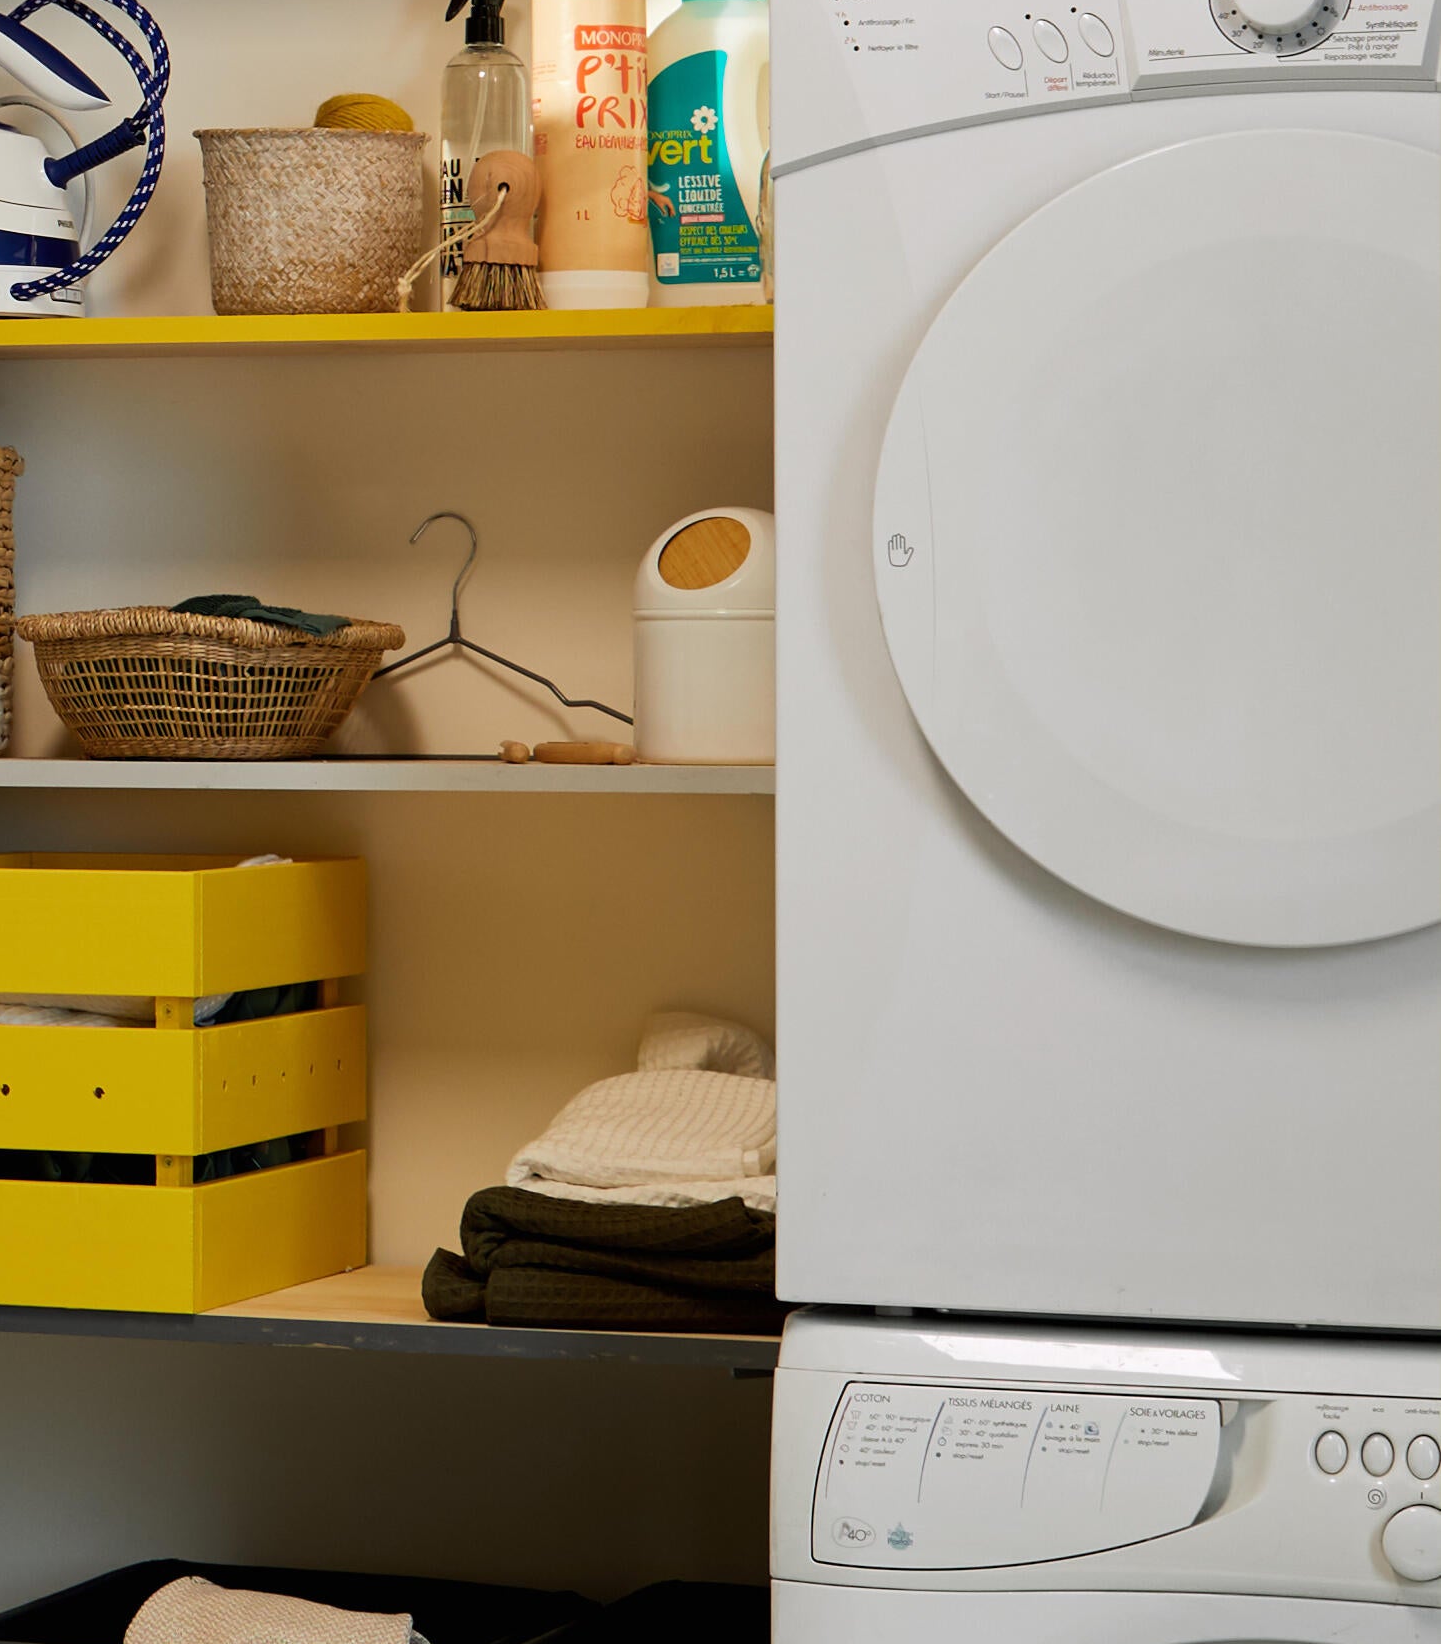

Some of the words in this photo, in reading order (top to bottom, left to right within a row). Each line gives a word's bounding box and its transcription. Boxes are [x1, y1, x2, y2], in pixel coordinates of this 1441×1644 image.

[1365, 20, 1419, 30] Synthétiques
[1371, 42, 1399, 52] ranger
[575, 135, 597, 150] EAU
[648, 130, 694, 142] ONOPRIX
[647, 134, 713, 166] vert
[678, 174, 722, 189] LESSIVE
[678, 188, 723, 203] LIQUIDE
[853, 1393, 891, 1404] COTON
[948, 1397, 979, 1407] TISSUS
[980, 1398, 1033, 1411] MÉLANGÉS
[1049, 1404, 1081, 1414] LAINE
[1129, 1407, 1152, 1417] SOIE
[1158, 1408, 1207, 1420] VOILAGES
